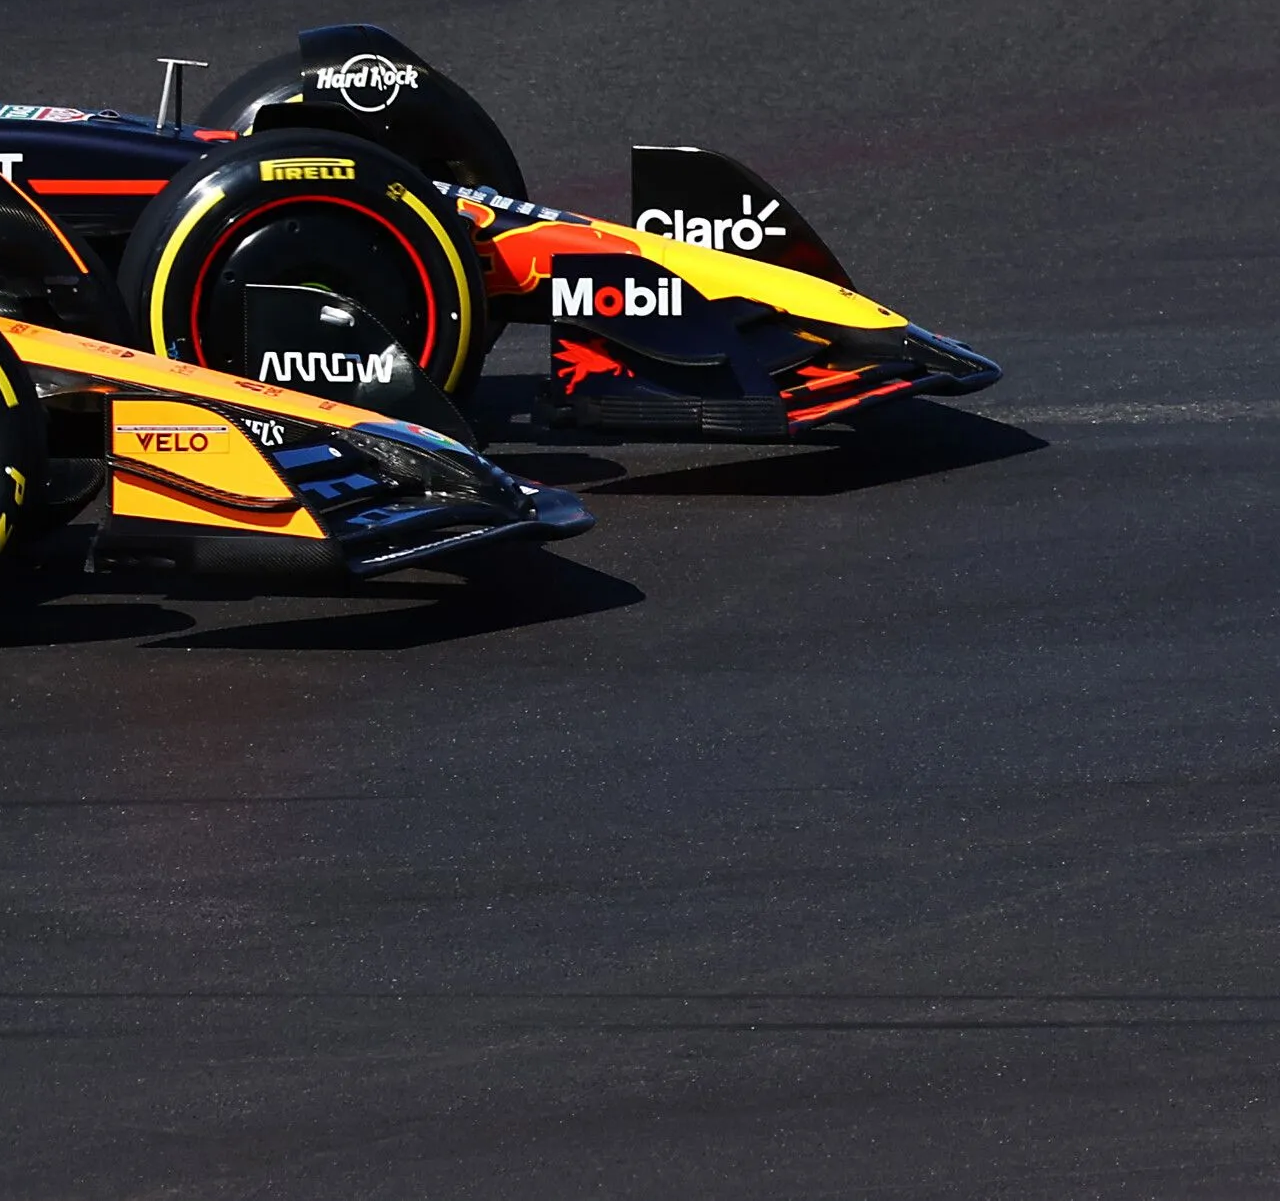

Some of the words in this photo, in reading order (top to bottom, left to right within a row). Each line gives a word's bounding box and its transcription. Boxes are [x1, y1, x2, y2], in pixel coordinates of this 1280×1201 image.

[316, 65, 369, 89] Hard
[370, 63, 419, 91] Rock
[260, 157, 356, 181] PIRELLI
[636, 209, 764, 250] Claro
[552, 277, 682, 316] Mobil
[136, 433, 209, 452] VELO
[9, 466, 26, 506] P
